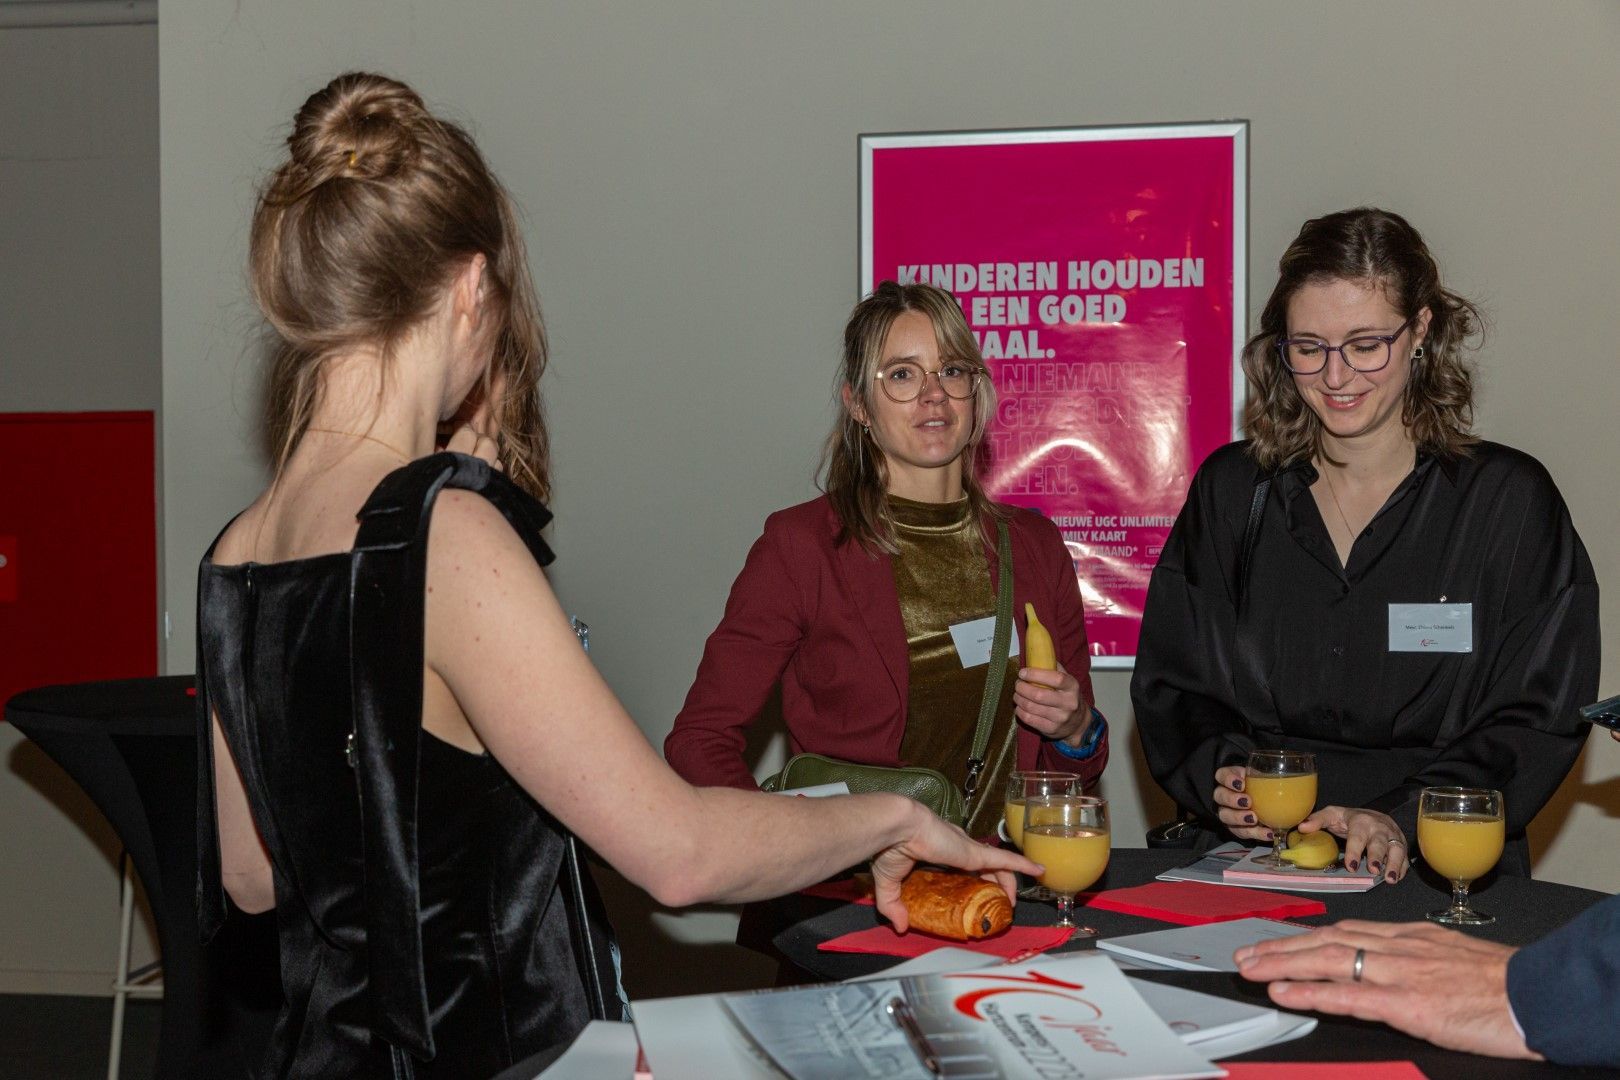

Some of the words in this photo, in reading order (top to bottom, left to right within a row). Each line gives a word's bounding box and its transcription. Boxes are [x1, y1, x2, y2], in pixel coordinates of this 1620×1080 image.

[898, 261, 1058, 292] KINDEREN
[1067, 258, 1204, 290] HOUDEN
[971, 297, 1029, 326] EEN
[1038, 294, 1127, 324] GOED
[1051, 516, 1093, 527] NIEUWE
[1095, 516, 1118, 527] UGC
[1063, 531, 1089, 542] MILY
[1091, 530, 1127, 542] KAART
